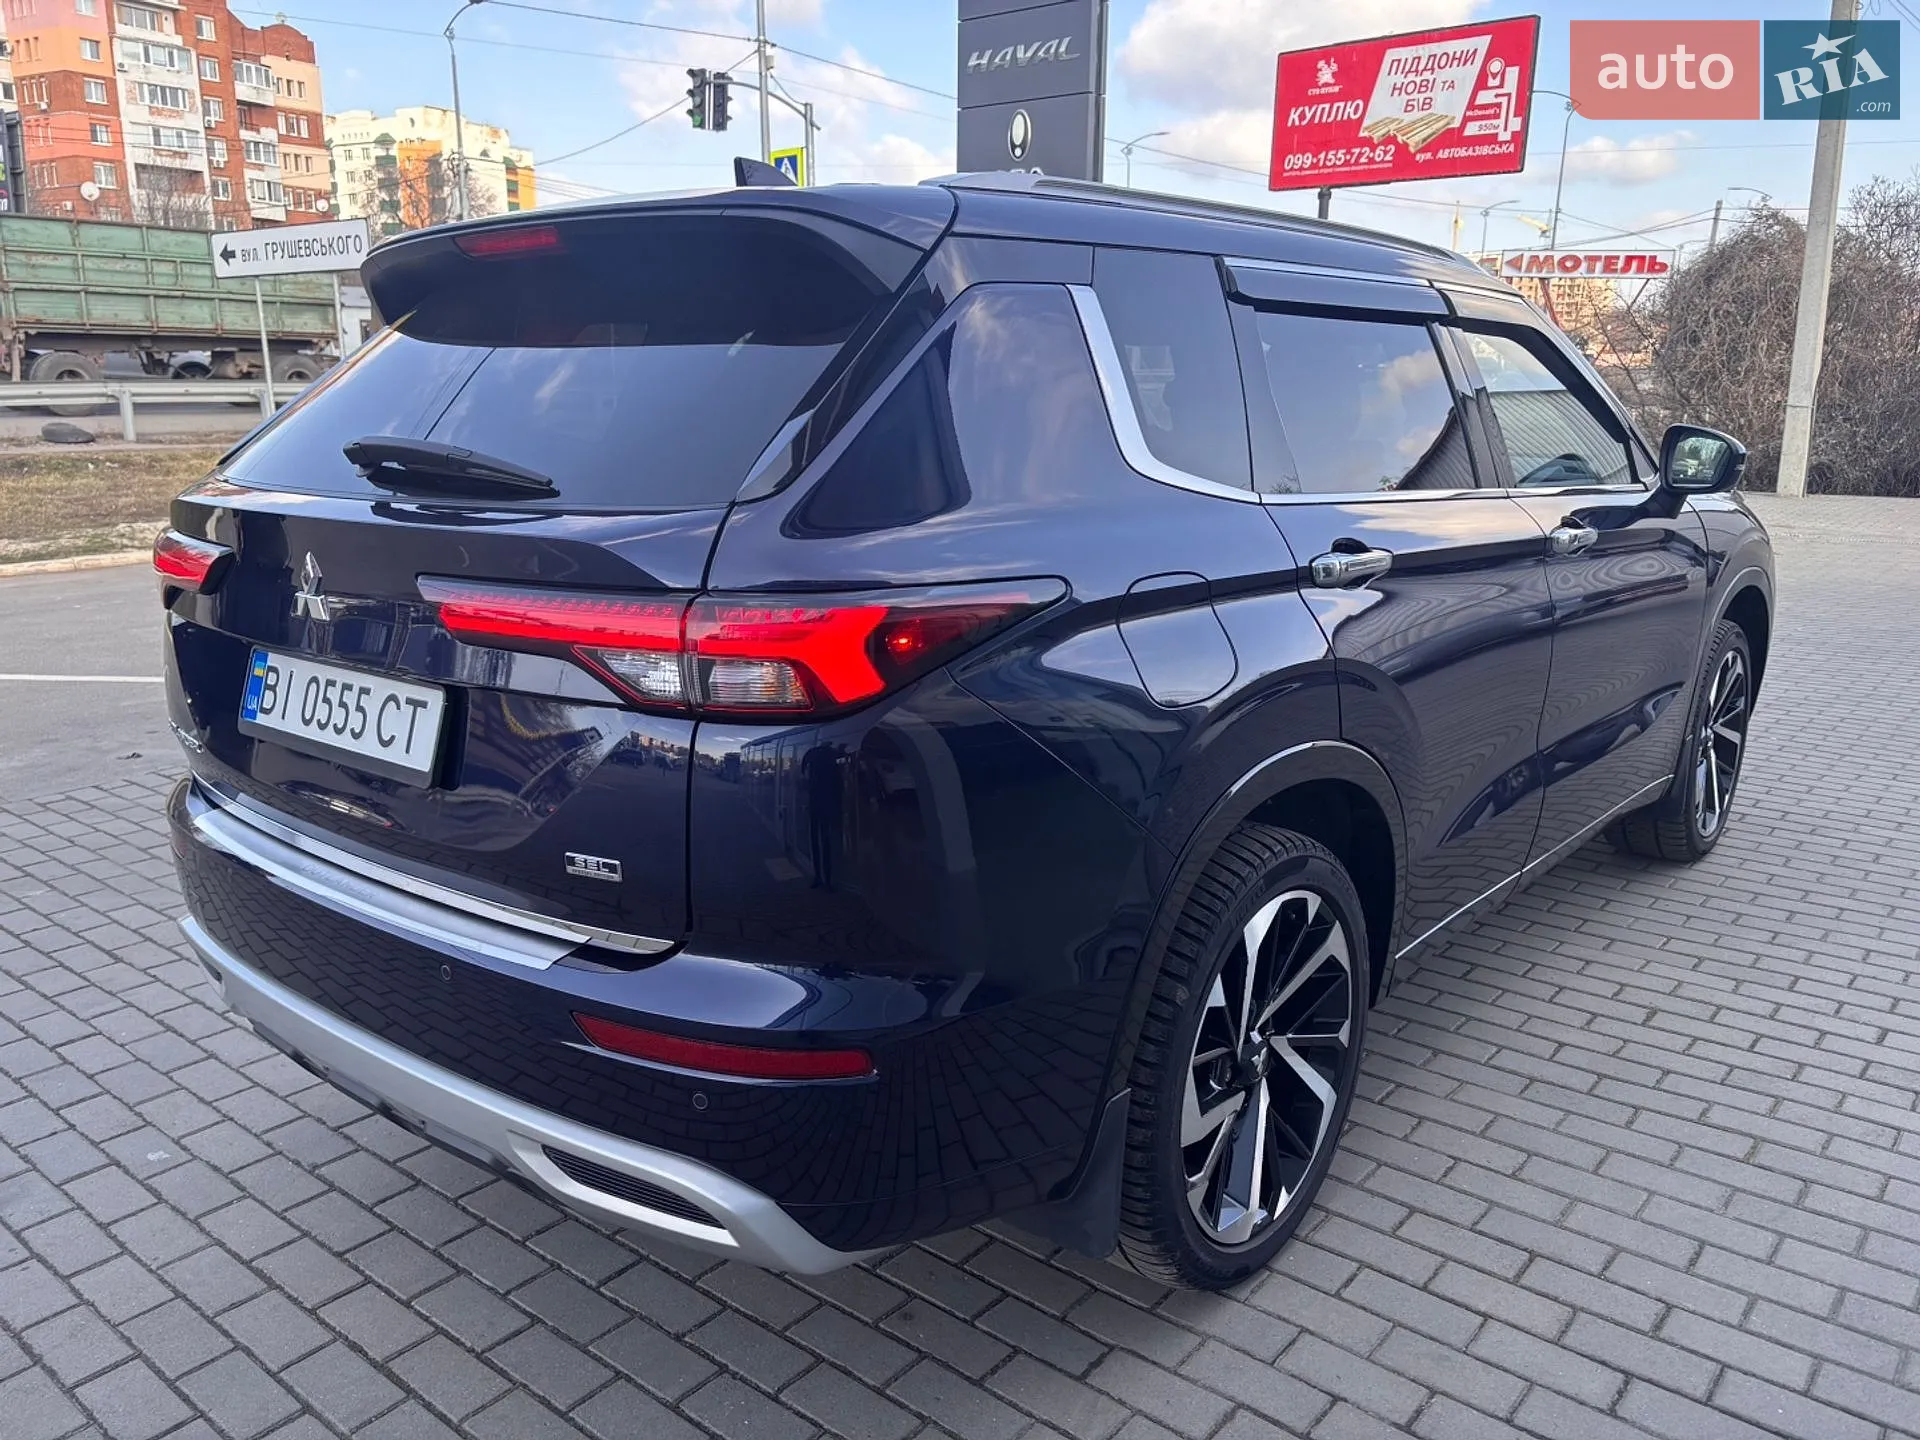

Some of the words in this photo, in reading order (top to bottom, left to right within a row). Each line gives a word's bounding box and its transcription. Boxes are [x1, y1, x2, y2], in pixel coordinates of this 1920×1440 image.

[967, 36, 1081, 73] HAVAL
[1387, 48, 1479, 78] ПІДДОНИ
[1390, 78, 1436, 97] НОВІ
[1440, 80, 1456, 92] ТА
[1287, 99, 1364, 127] КУПЛЮ
[1436, 143, 1515, 160] АВТОБАЗІВСЬКА
[264, 234, 362, 261] ГРУШЕВСЬКОГО
[1524, 254, 1669, 274] МОТЕЛЬ
[246, 695, 258, 711] UA
[259, 665, 294, 720] BI
[301, 675, 371, 740] 0555
[377, 693, 428, 754] CT
